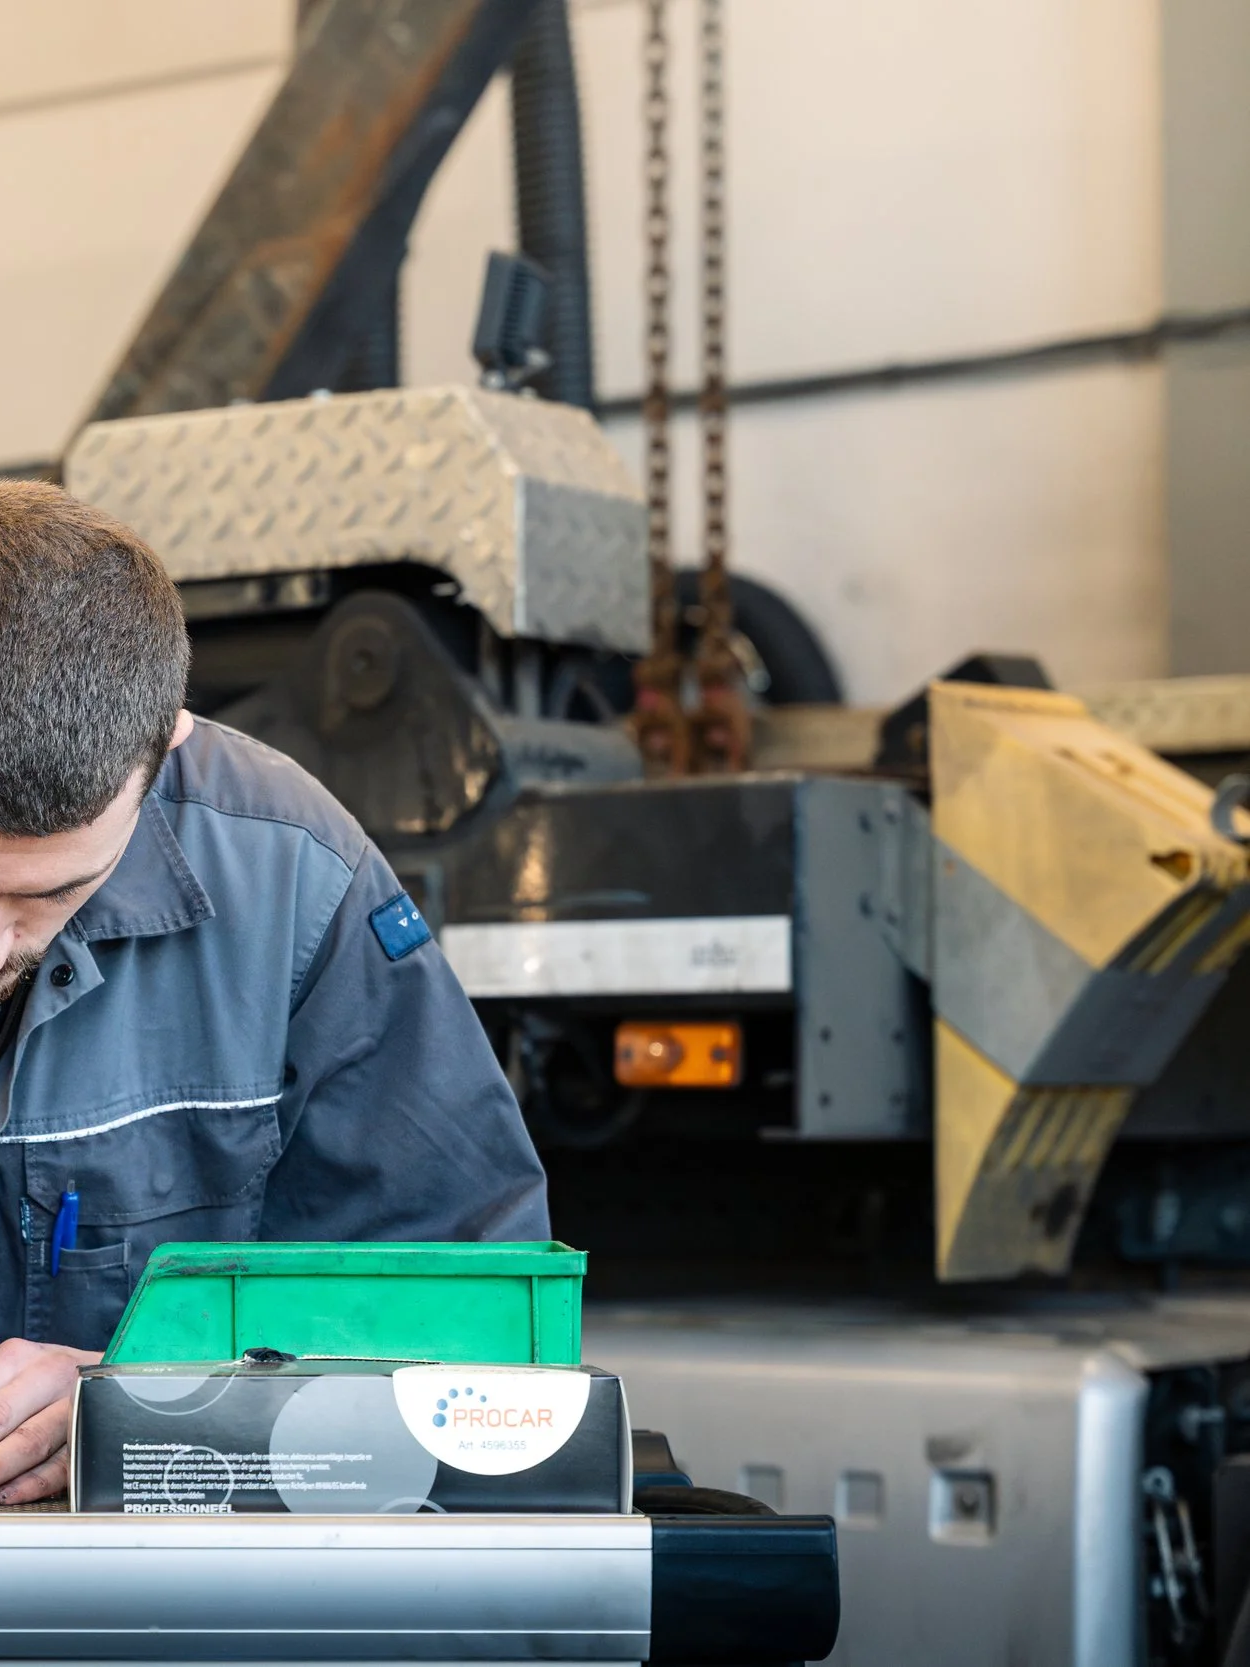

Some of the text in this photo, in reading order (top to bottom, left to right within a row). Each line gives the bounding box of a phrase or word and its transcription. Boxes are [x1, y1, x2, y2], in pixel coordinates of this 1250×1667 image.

[453, 1409, 553, 1427] PROCAR
[480, 1440, 527, 1450] 4596355
[124, 1504, 236, 1513] PROFESSIONEEL
